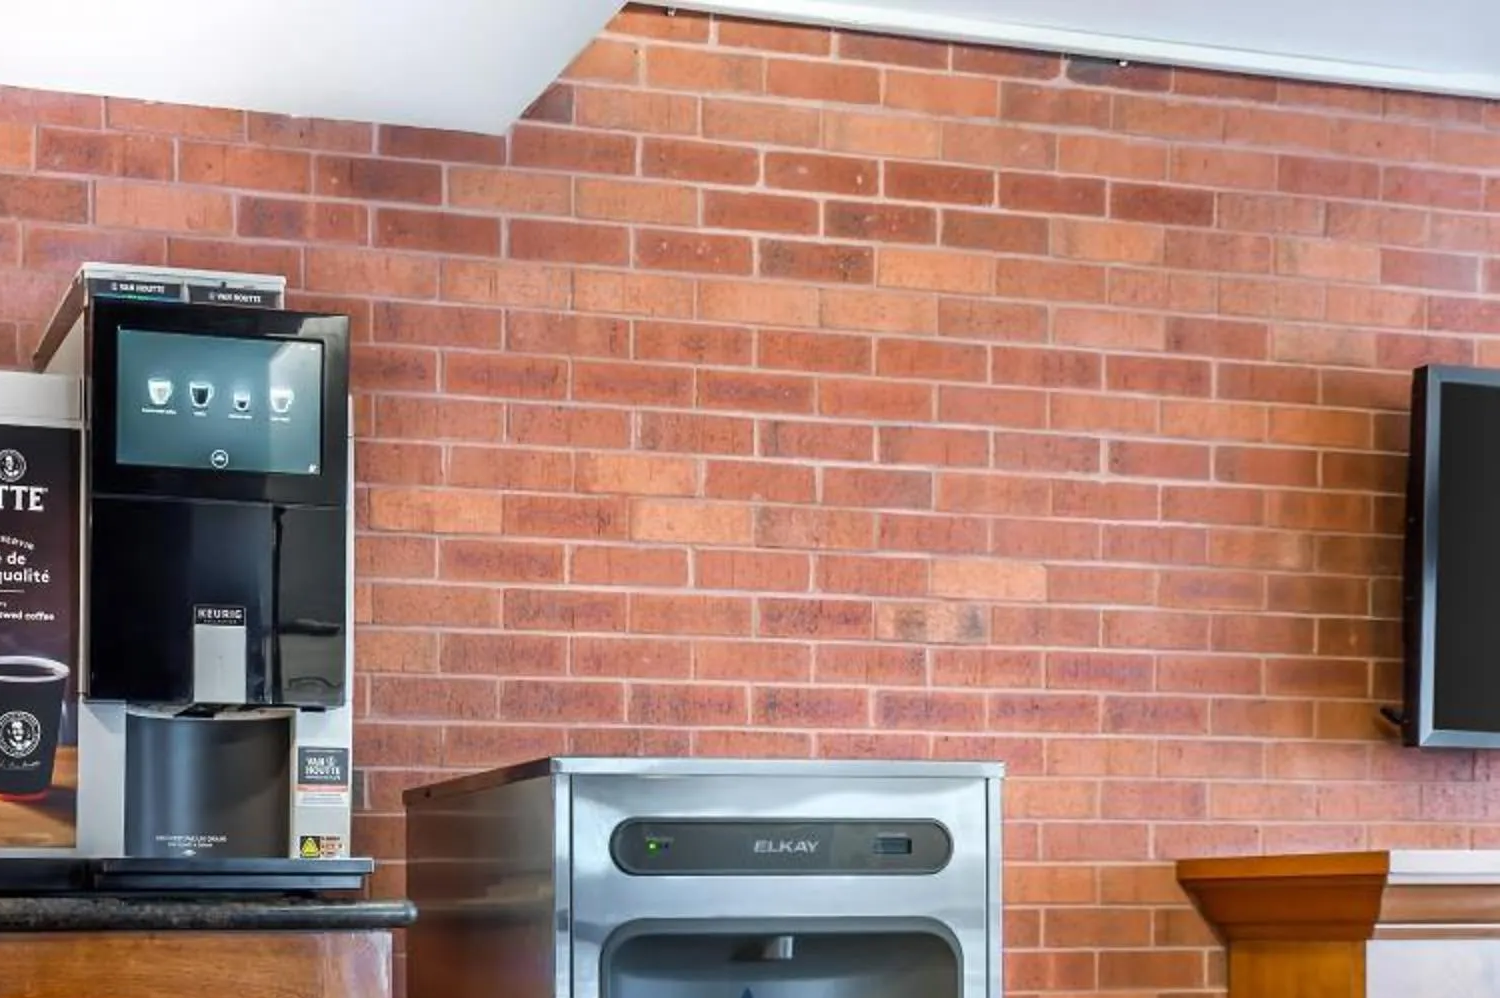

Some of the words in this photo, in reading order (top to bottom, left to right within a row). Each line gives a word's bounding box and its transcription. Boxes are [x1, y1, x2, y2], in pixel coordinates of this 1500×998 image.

[7, 551, 27, 565] de
[24, 611, 55, 621] coffee
[197, 608, 242, 619] KEURIG
[754, 839, 819, 853] ELKAY
